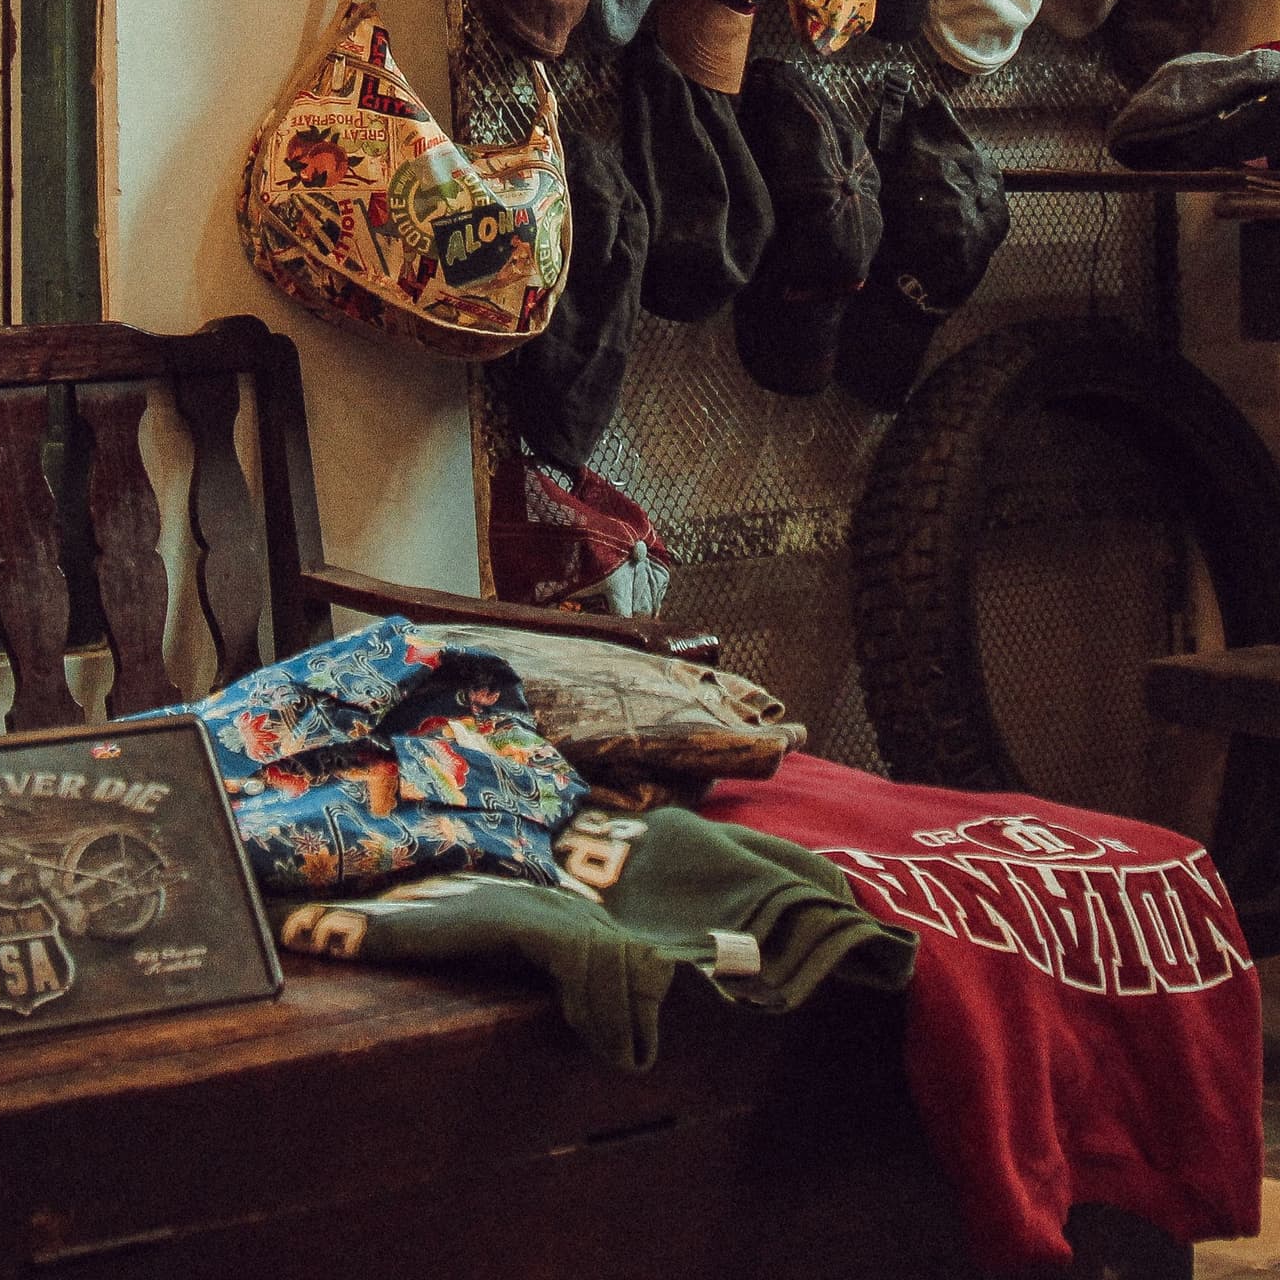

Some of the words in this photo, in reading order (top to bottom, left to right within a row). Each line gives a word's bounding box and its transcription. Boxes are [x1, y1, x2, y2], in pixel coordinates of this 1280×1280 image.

[361, 95, 405, 113] CITY
[290, 111, 364, 129] PHOSPHATE
[342, 129, 387, 142] GREAT
[445, 208, 529, 267] ALOHA
[92, 776, 170, 814] DIE
[815, 848, 1256, 997] NDIANA
